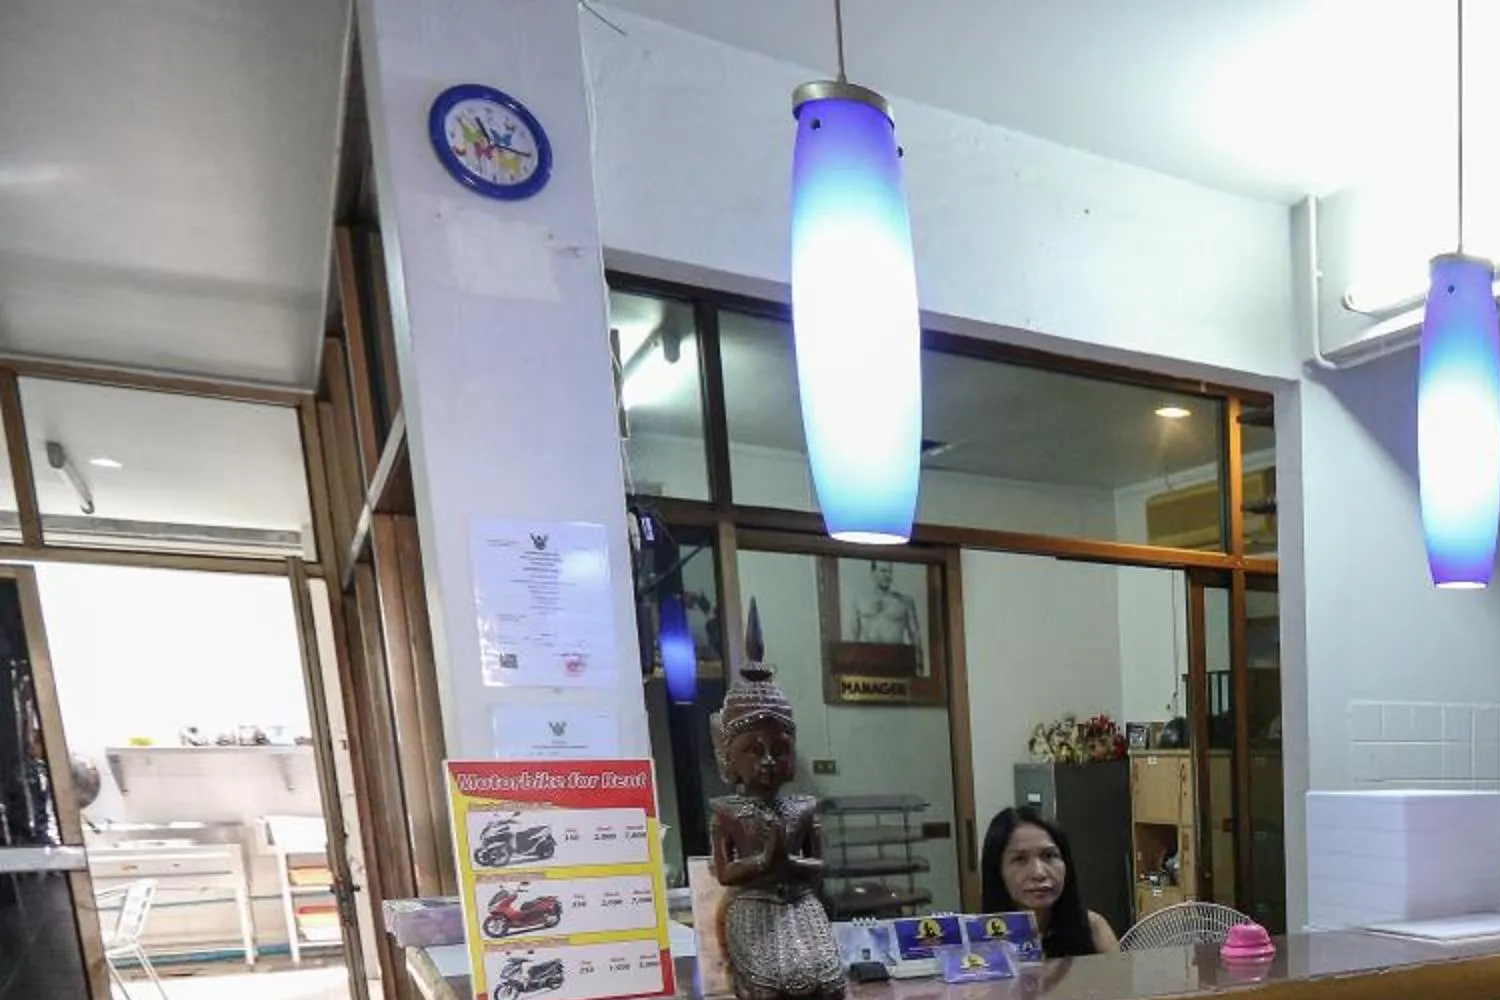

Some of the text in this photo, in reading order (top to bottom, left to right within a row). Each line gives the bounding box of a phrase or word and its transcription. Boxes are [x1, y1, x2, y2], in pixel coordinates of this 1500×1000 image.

[841, 680, 907, 696] MANAGER
[568, 771, 599, 790] for
[601, 771, 648, 789] Rent
